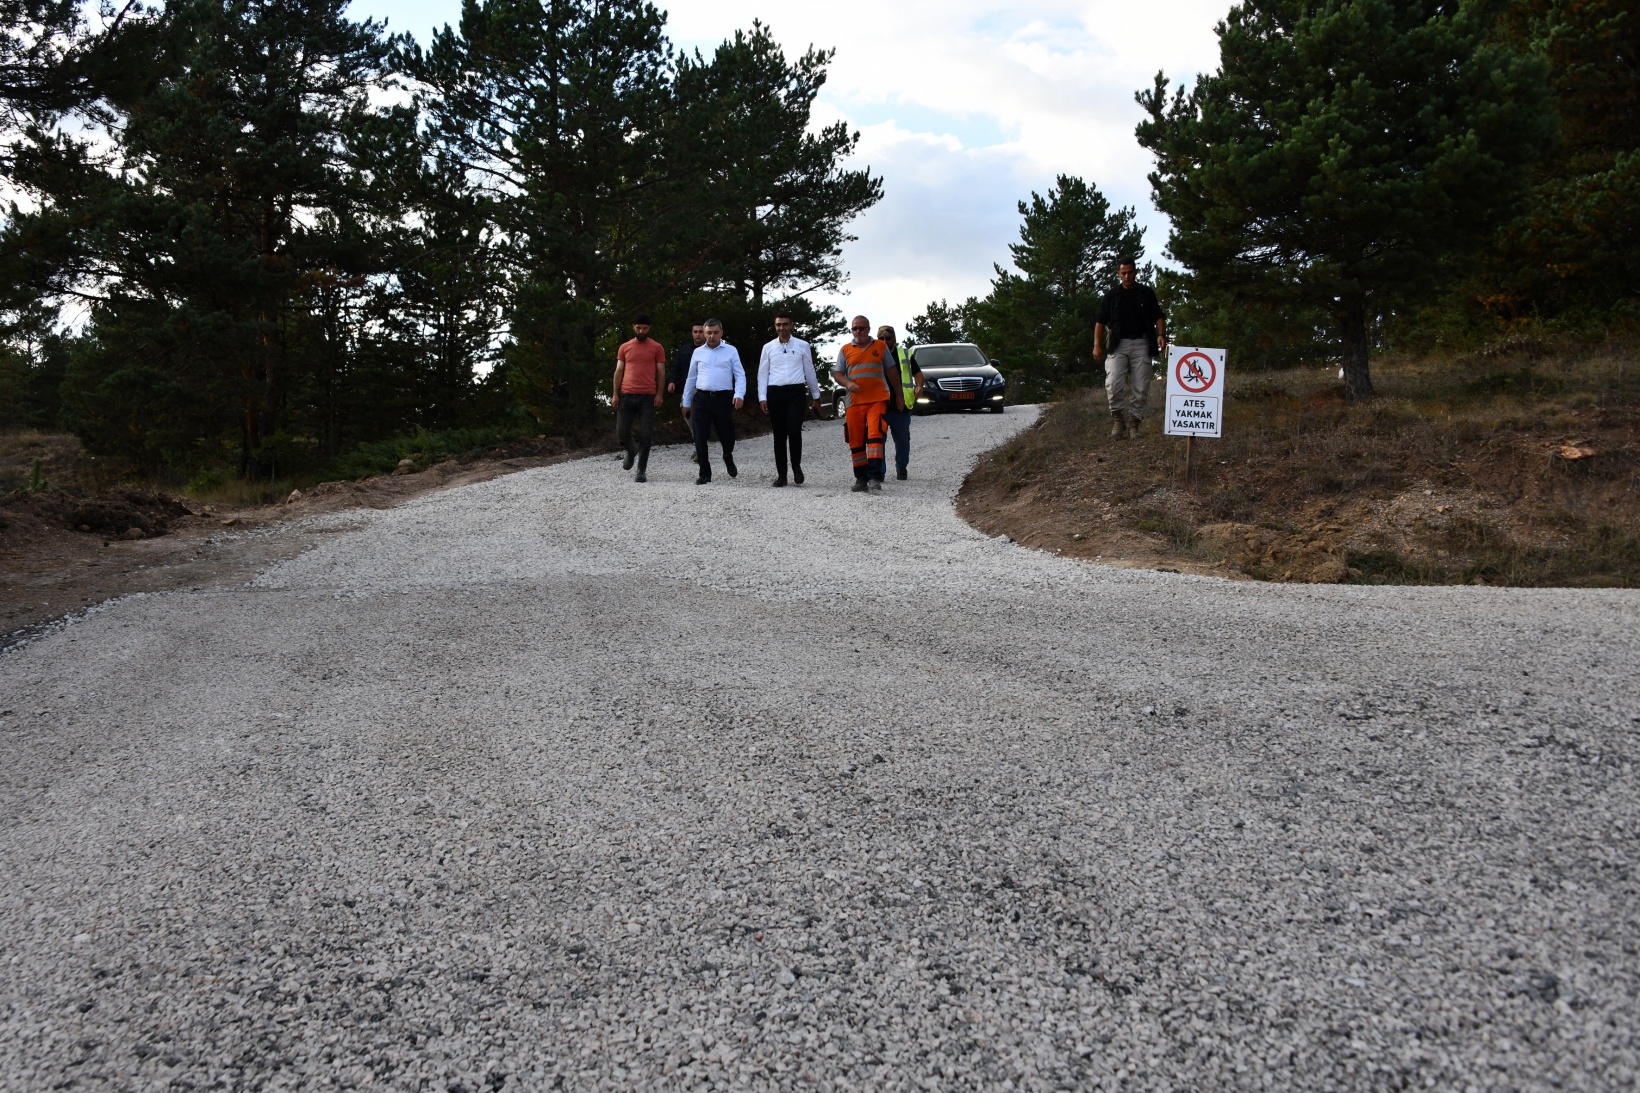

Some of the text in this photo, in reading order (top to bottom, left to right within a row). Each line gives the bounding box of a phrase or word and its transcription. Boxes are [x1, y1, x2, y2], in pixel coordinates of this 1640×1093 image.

[1183, 399, 1205, 410] ATEŞ
[1175, 409, 1212, 419] YAKMAK
[1172, 420, 1215, 429] YASAKTIR
